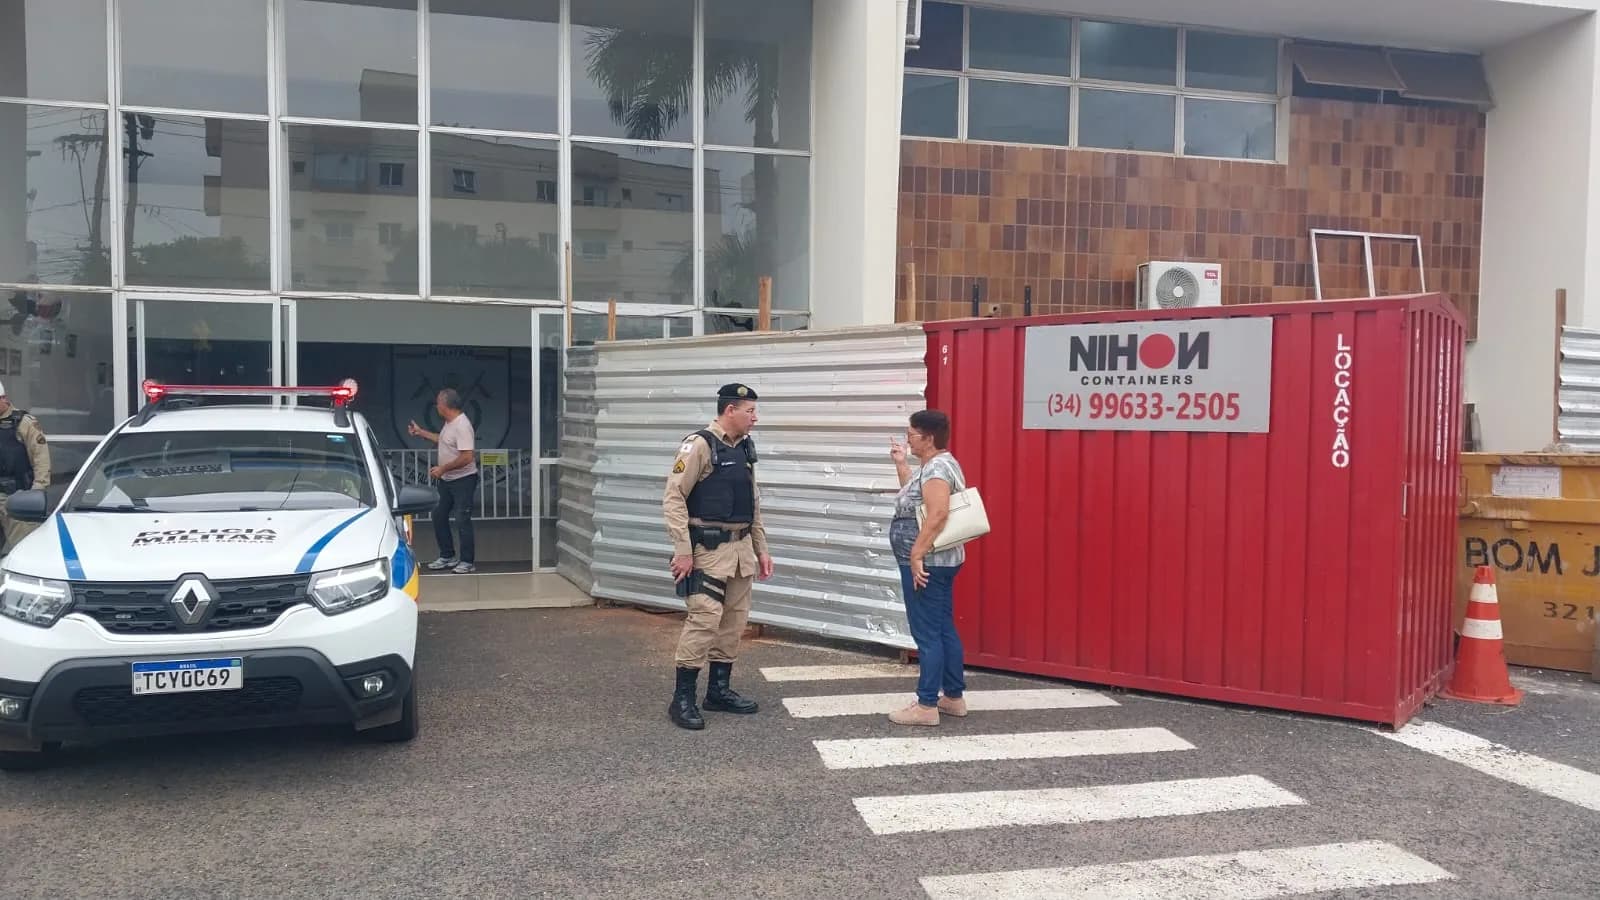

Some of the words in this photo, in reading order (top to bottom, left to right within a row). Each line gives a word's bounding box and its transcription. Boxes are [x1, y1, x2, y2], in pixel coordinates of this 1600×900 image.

[1069, 331, 1210, 372] NIHON
[1081, 375, 1194, 386] CONTAINERS
[1047, 393, 1082, 418] (34)
[1088, 392, 1240, 421] 99633-2505
[1331, 333, 1352, 468] LOCAÇÃO
[134, 534, 277, 544] MILITAR
[1465, 537, 1563, 576] BOM
